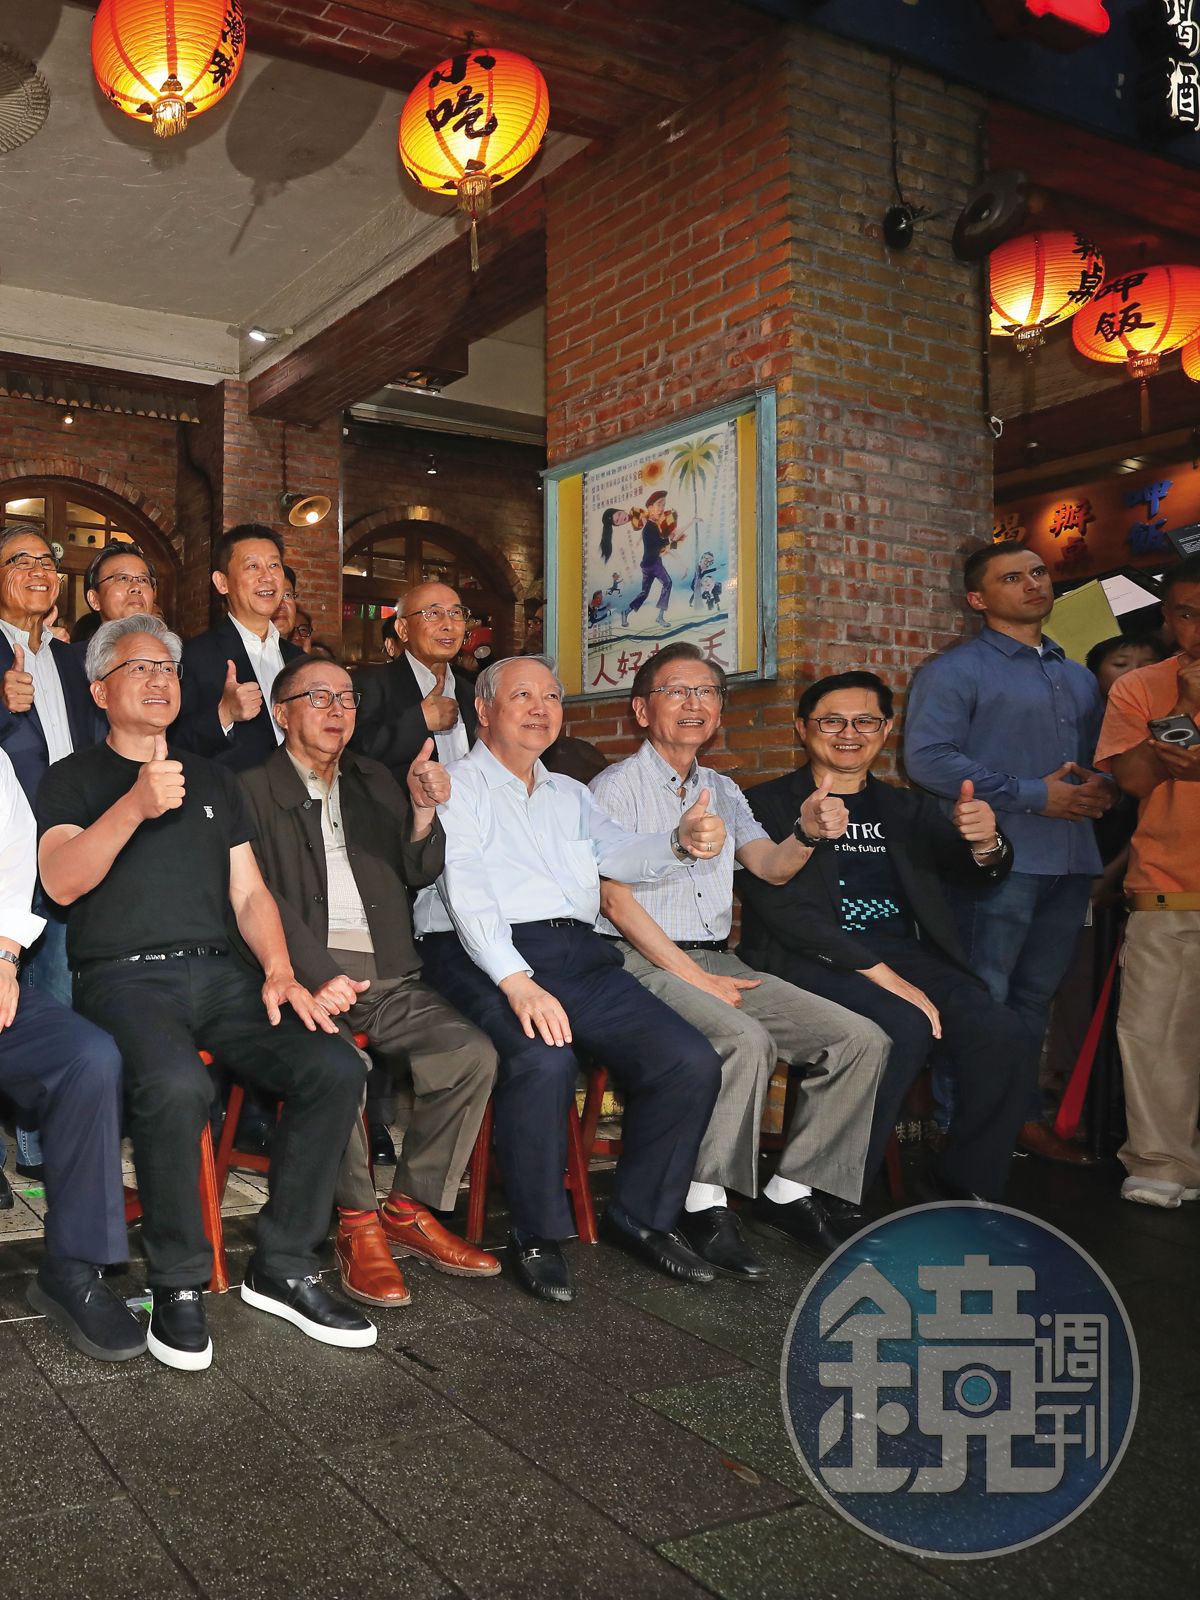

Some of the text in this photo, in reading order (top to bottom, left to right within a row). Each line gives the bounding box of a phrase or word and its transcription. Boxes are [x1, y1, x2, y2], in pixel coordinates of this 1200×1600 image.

[427, 52, 497, 139] 小吃
[1094, 272, 1156, 342] 呷飯
[842, 843, 857, 852] the
[858, 844, 887, 853] future
